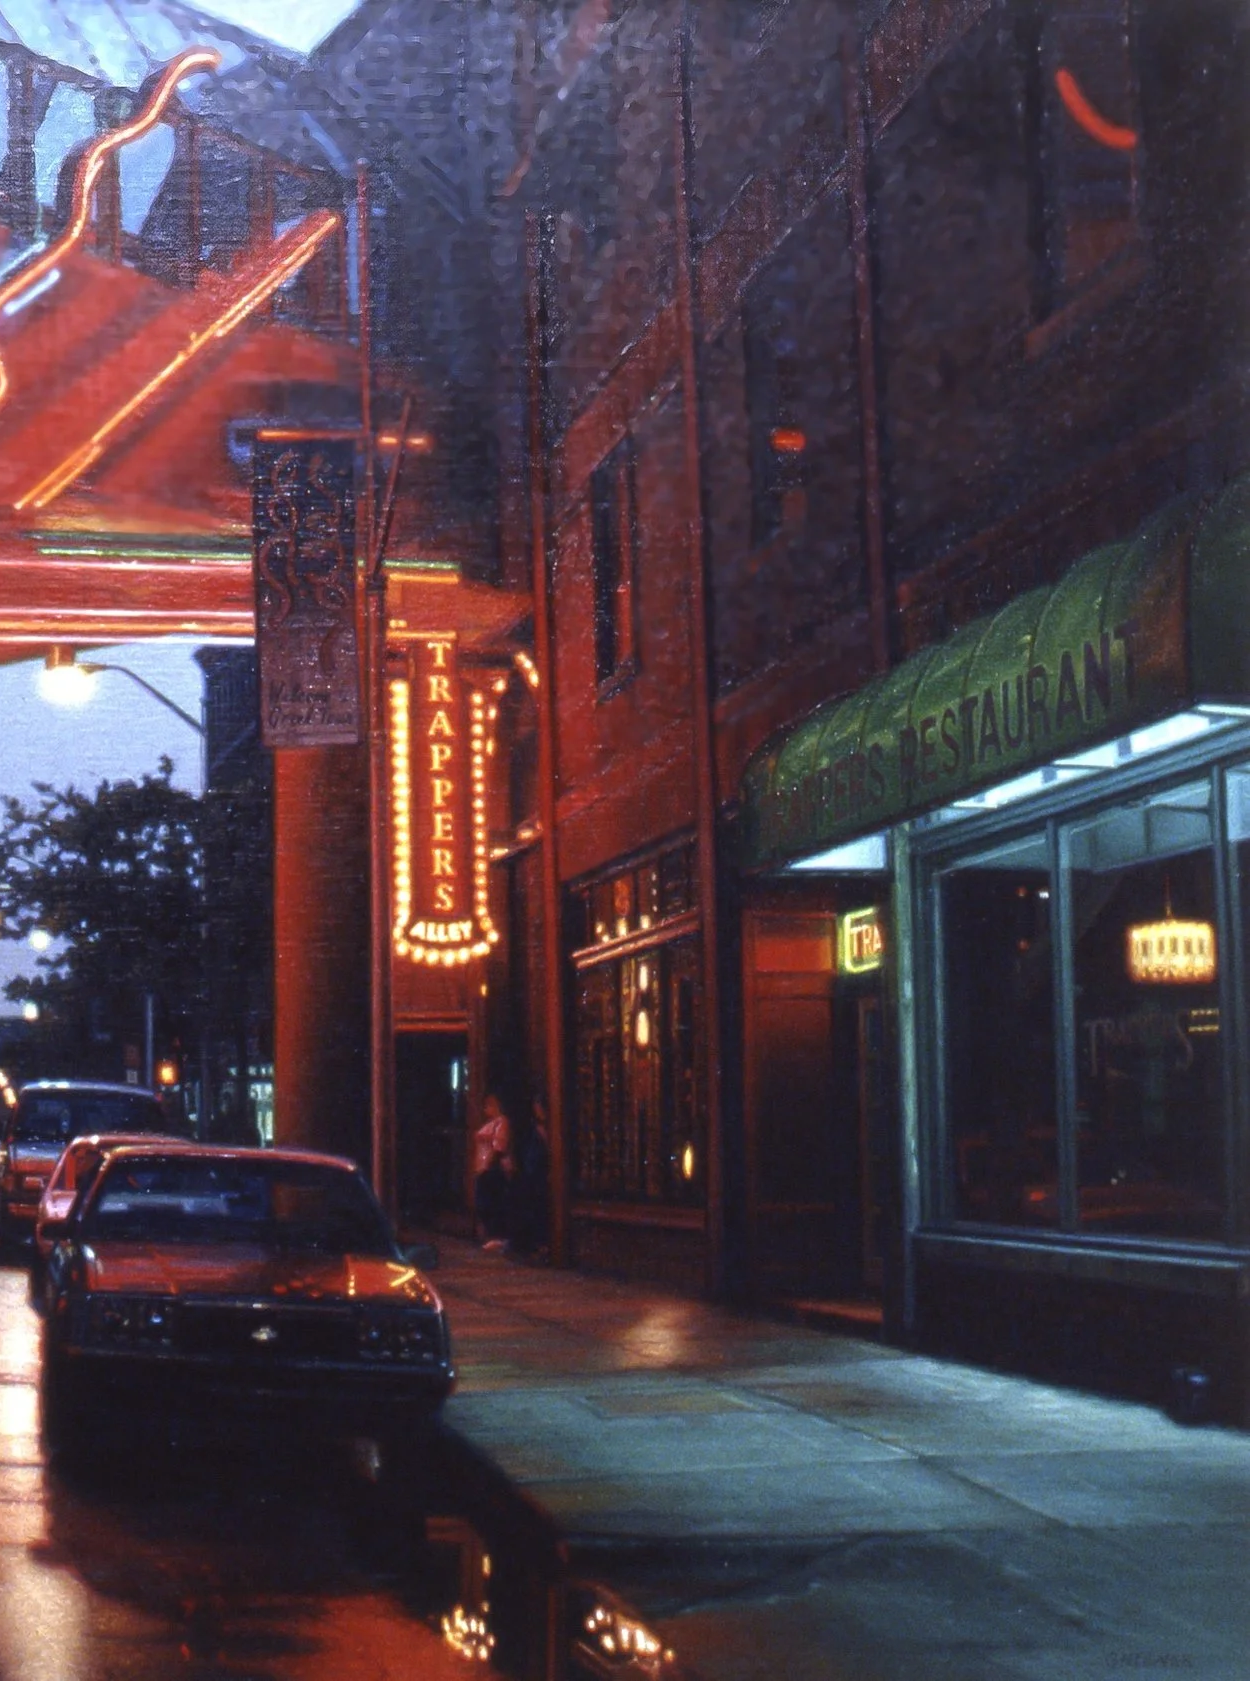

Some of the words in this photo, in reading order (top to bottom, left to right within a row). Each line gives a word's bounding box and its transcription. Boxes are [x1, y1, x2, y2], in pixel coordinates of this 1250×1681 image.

[428, 642, 454, 911] TRAPPERS
[898, 620, 1141, 790] RESTAURANT
[410, 920, 472, 942] ALLEY
